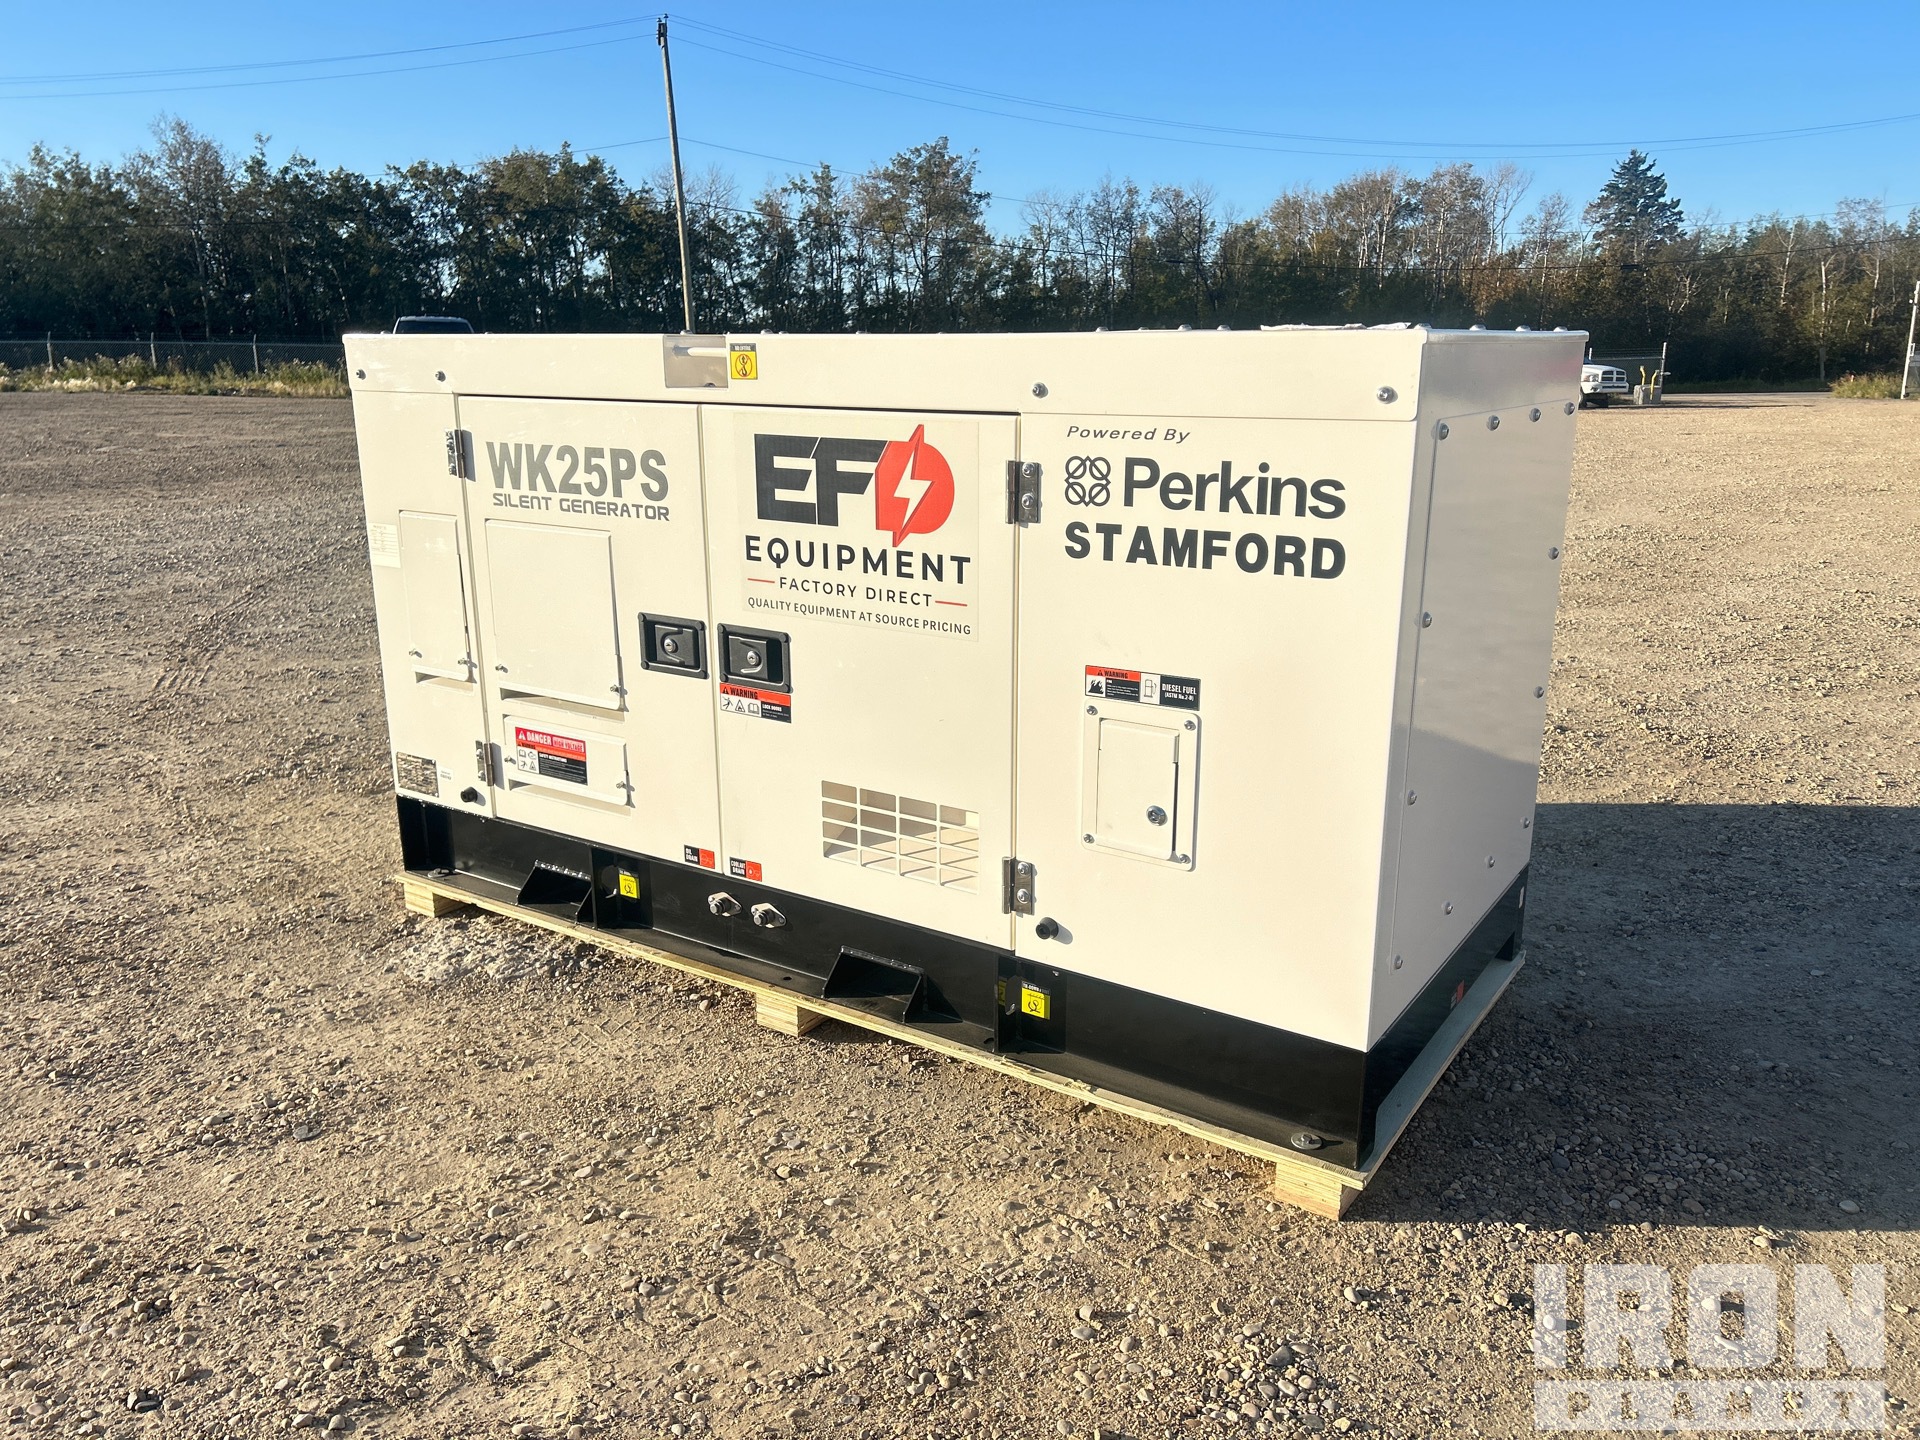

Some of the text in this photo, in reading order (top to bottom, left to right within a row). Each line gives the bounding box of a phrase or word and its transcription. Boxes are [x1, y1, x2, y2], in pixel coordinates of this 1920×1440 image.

[1066, 425, 1191, 444] Powered By
[485, 441, 669, 502] WK25PS
[1123, 456, 1347, 520] Perkins
[492, 492, 670, 522] SILENT GENERATOR
[745, 534, 971, 585] EQUIPMENT
[1064, 521, 1347, 580] STAMFORD
[779, 576, 933, 607] FACTORY DIRECT
[747, 596, 972, 636] QUALITY EQUIPMENT AT SOURCE PRICING
[1104, 670, 1129, 679] WARNING
[730, 686, 758, 700] WARNING
[1161, 683, 1197, 695] DIESEL FUEL
[526, 731, 552, 746] DANGER
[565, 740, 584, 752] VOLTAGE
[686, 854, 698, 862] DRAIN
[732, 866, 745, 874] DRAIN
